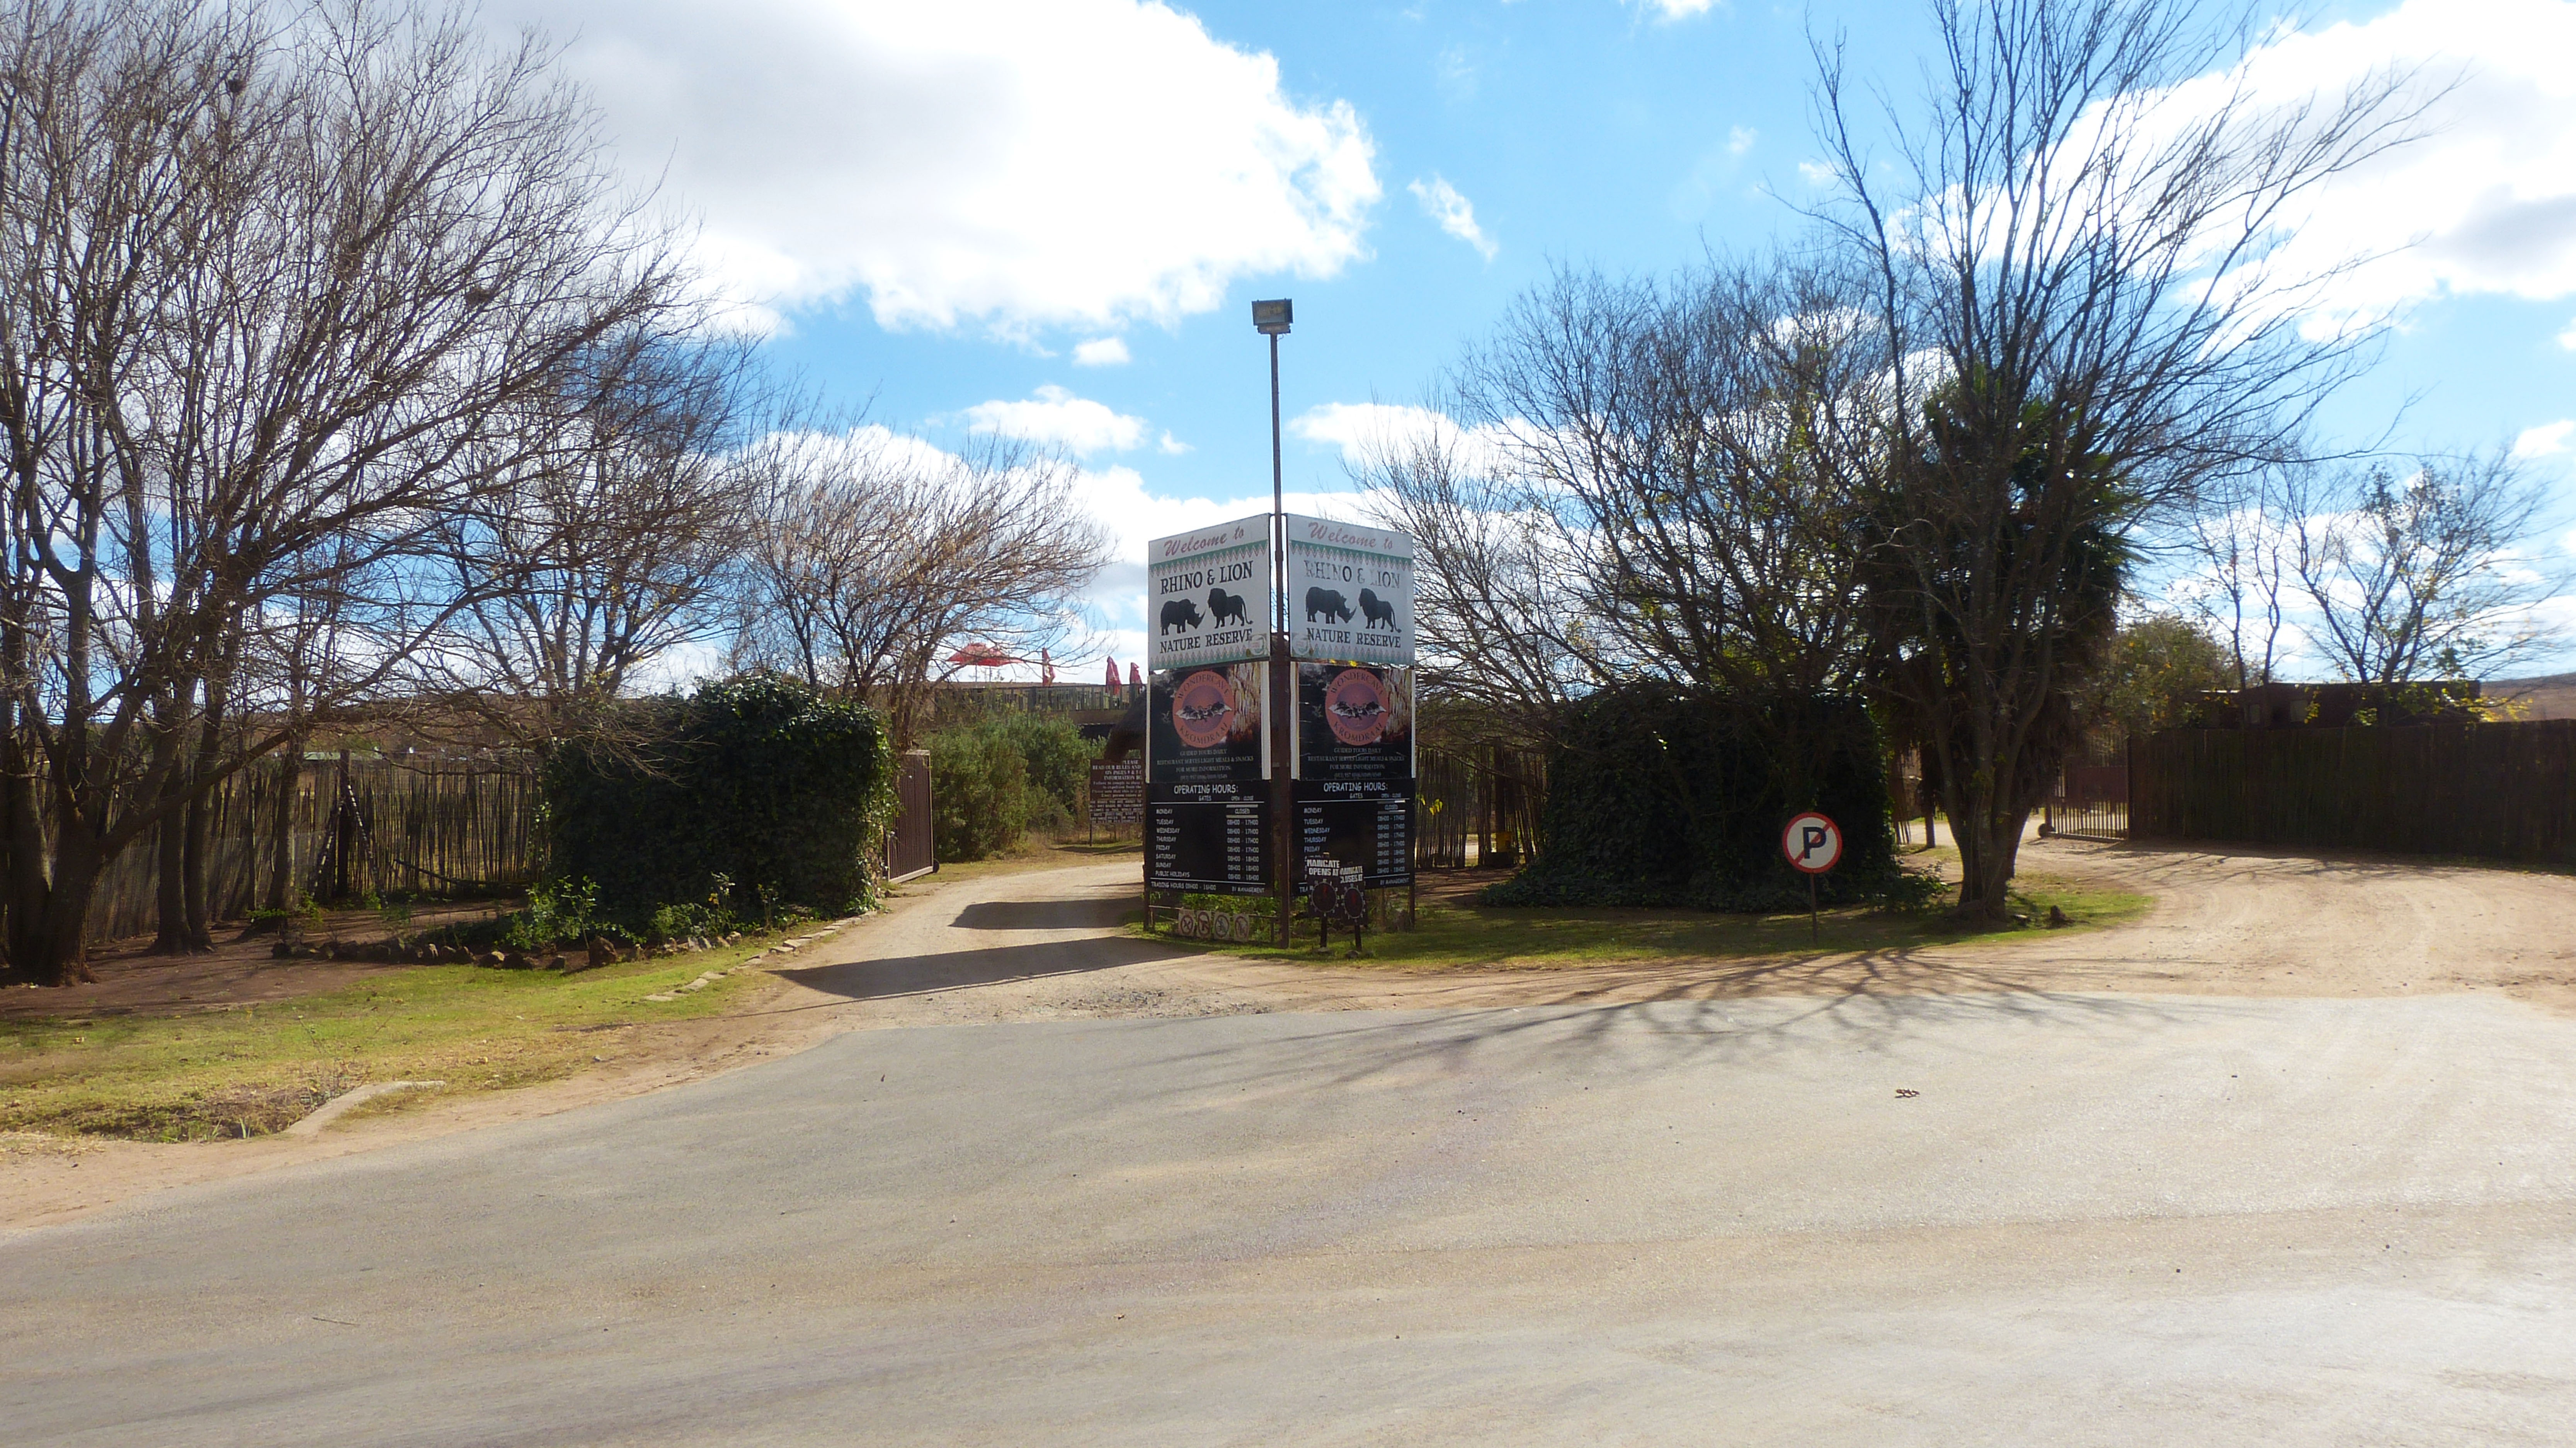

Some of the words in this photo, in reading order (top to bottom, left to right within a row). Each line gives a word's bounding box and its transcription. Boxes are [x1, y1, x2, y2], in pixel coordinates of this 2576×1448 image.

[1164, 533, 1227, 557] Welcome
[1233, 526, 1244, 540] to
[1308, 522, 1376, 547] Welcome
[1384, 537, 1393, 549] to
[1160, 571, 1203, 595] RHINO
[1207, 569, 1215, 585] &
[1220, 560, 1253, 583] LION
[1357, 568, 1365, 584] &
[1160, 636, 1200, 653] NATURE
[1205, 629, 1252, 647] RESERVE
[1307, 628, 1351, 644] NATURE
[1356, 632, 1401, 648] RESERVE
[1177, 675, 1230, 699] WONDERCAVE
[1331, 672, 1383, 695] WONDERCAVE
[1174, 784, 1210, 794] OPERATING
[1212, 785, 1238, 793] HOURS:
[1324, 782, 1362, 792] OPERATING
[1364, 782, 1388, 791] HOURS:
[1803, 827, 1826, 859] P
[1307, 859, 1340, 868] MAINGATE
